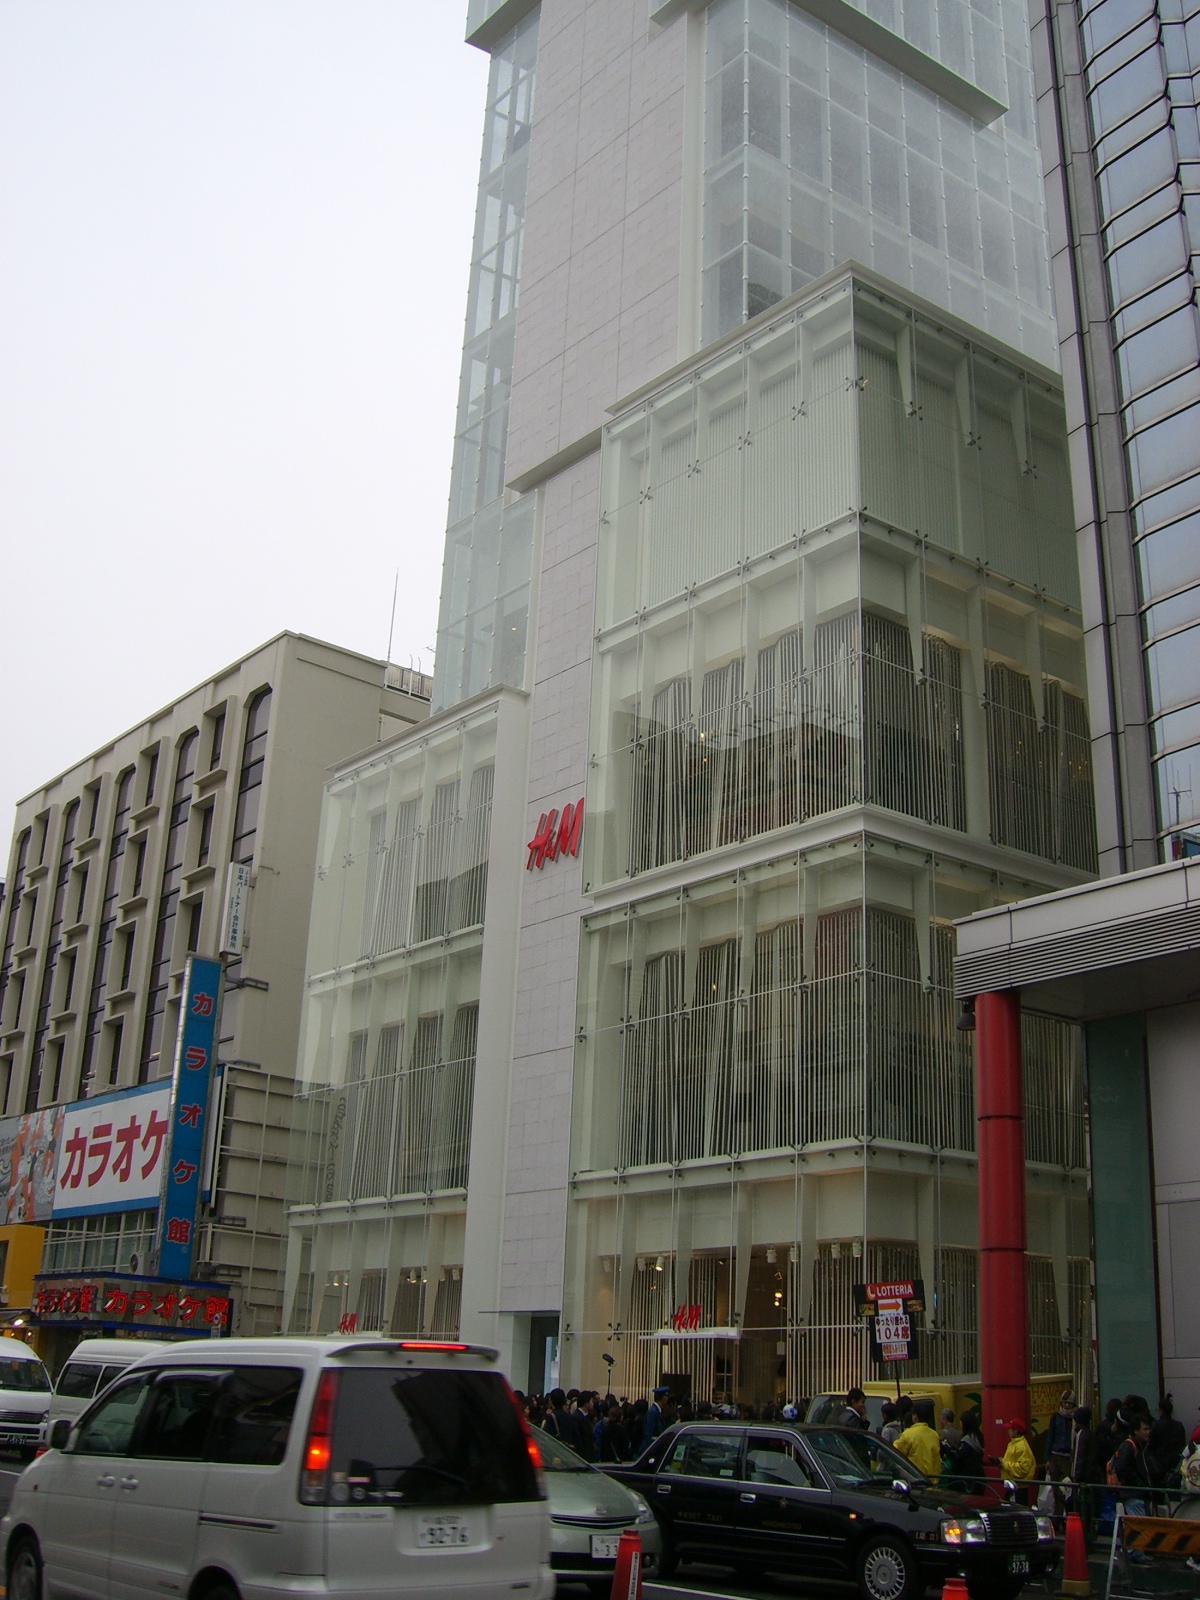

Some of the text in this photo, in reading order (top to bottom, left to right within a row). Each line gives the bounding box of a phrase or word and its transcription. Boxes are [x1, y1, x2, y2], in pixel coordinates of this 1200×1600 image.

[526, 797, 584, 871] H&M
[167, 991, 213, 1244] カラオケ館
[60, 1110, 168, 1190] カラオケ
[35, 1285, 92, 1313] カラオケ館
[104, 1288, 229, 1325] カラオケ館
[876, 1284, 913, 1297] LOTTERIA
[339, 1312, 358, 1334] H&M
[672, 1304, 701, 1332] H&M
